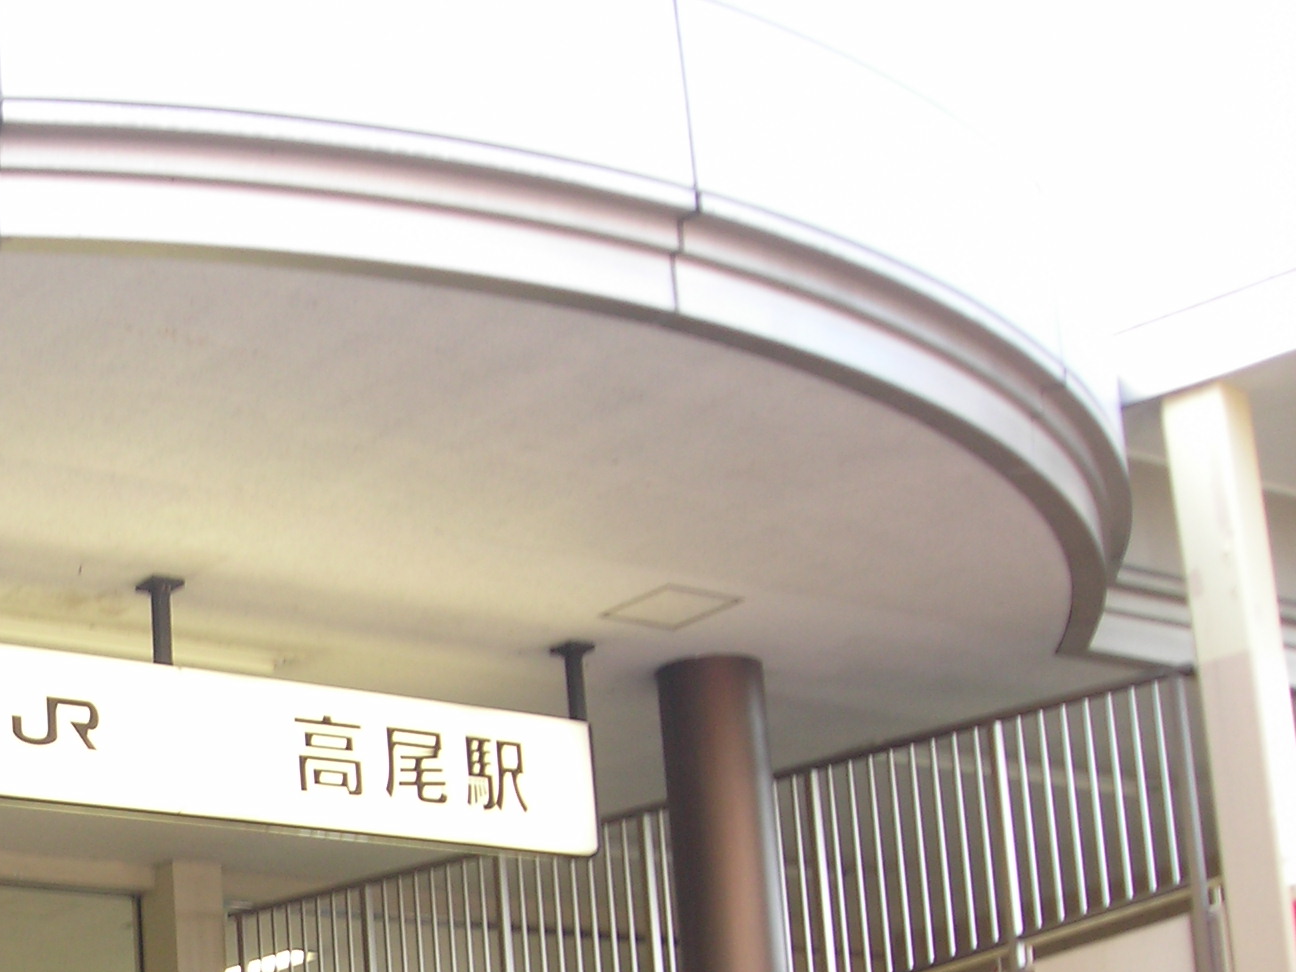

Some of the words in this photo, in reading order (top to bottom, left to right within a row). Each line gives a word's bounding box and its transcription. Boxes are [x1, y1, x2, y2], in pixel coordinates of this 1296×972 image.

[11, 696, 99, 750] JR
[294, 715, 528, 813] 高尾駅
